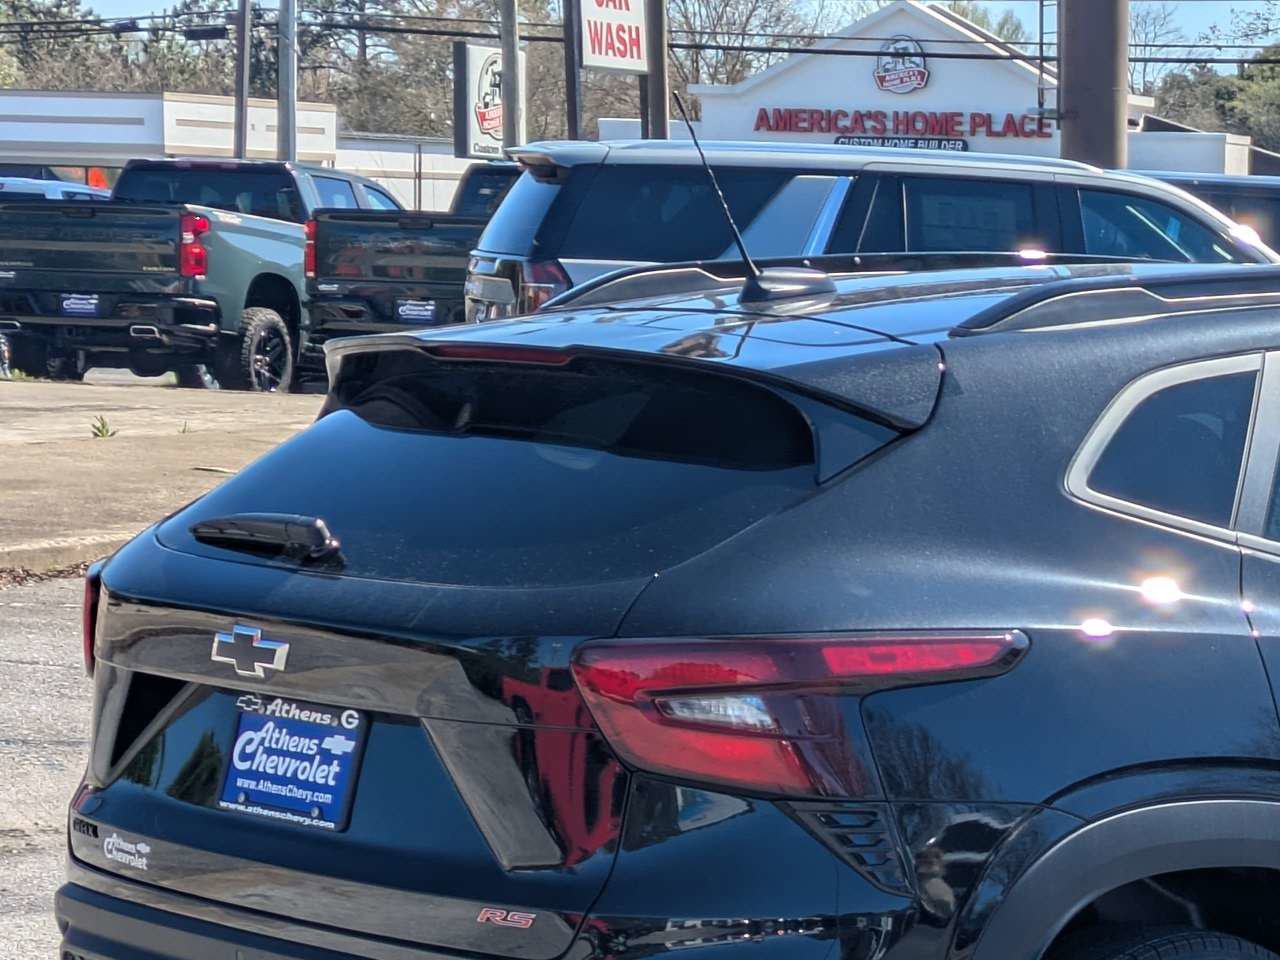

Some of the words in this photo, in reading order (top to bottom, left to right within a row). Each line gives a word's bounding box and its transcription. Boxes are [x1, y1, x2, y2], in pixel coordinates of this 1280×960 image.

[587, 19, 641, 60] WASH
[754, 107, 888, 135] AMERICA'S
[893, 110, 963, 137] HOME
[969, 112, 1053, 138] PLACE
[265, 698, 332, 726] Athens
[245, 721, 320, 755] Athens
[232, 730, 342, 786] Chevrolet
[236, 777, 332, 804] www.AthensChevy.com
[219, 800, 335, 829] www.athenschevy.com
[103, 837, 148, 871] Chevrolet
[108, 832, 136, 853] Athens
[477, 907, 537, 929] RS
